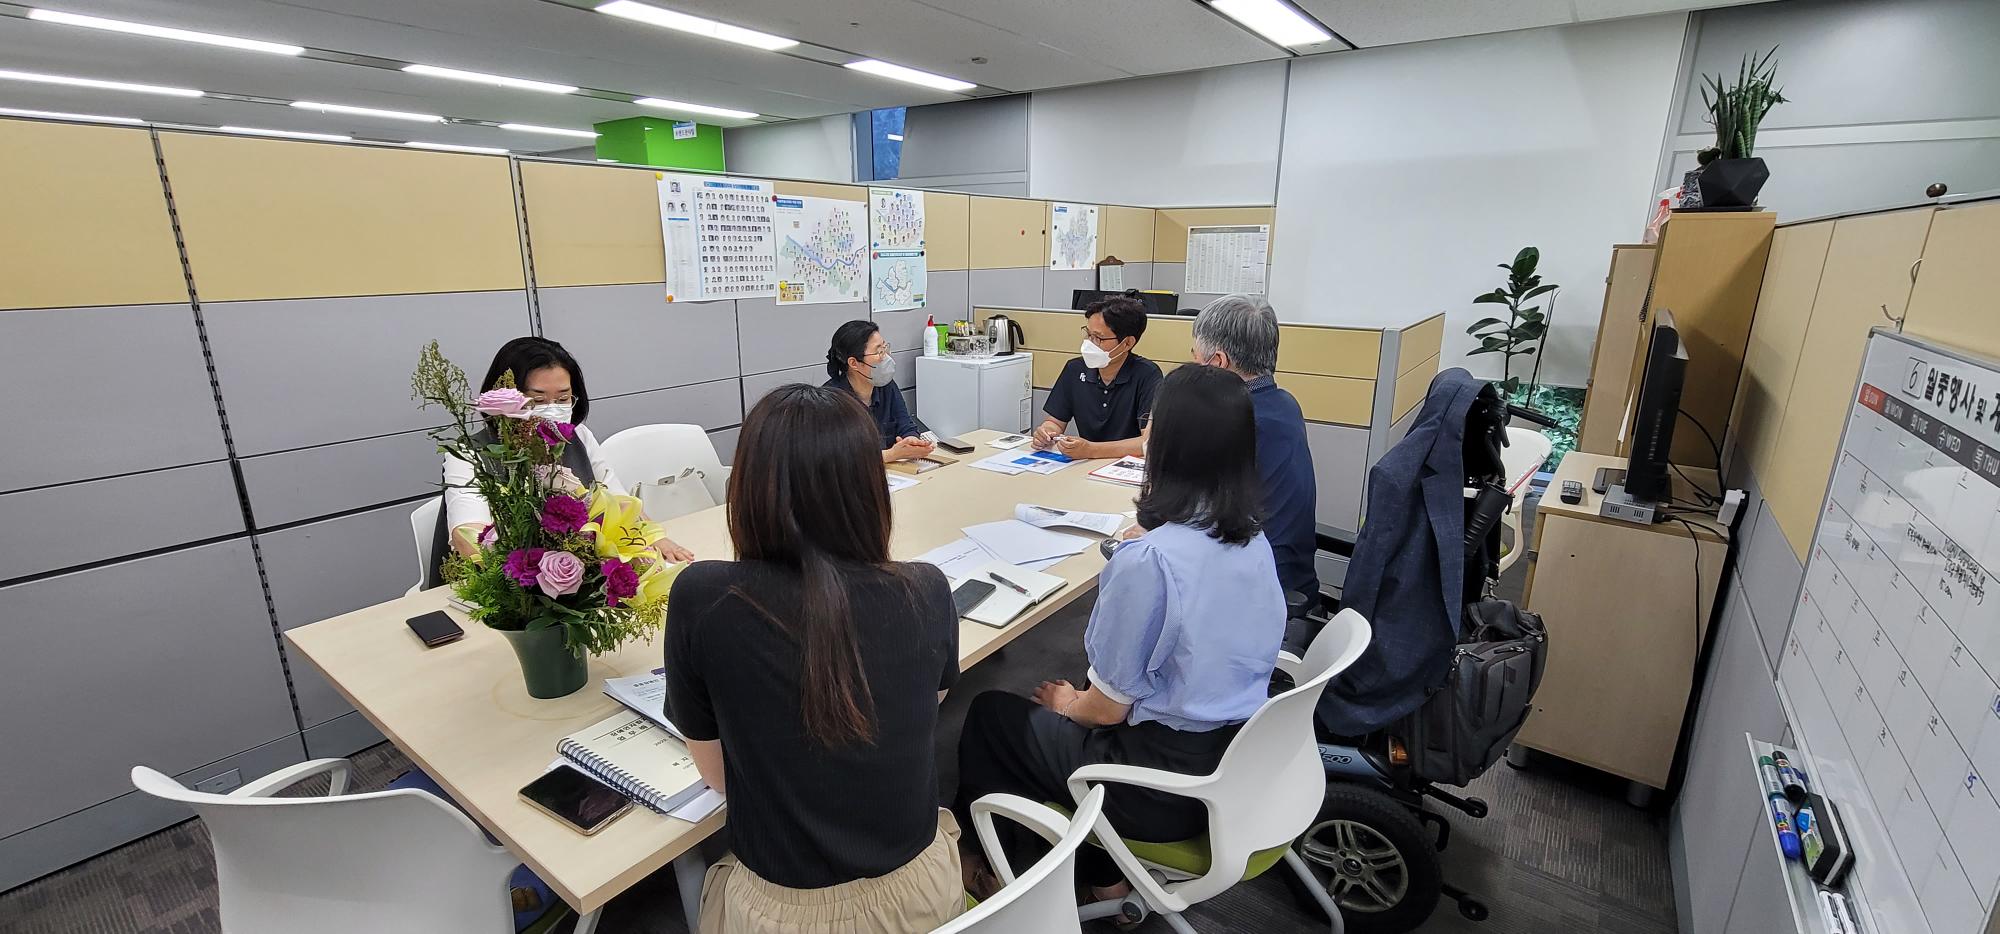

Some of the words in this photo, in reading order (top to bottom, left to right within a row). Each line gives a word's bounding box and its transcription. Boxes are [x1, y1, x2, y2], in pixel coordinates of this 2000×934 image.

[1909, 361, 1920, 390] 6
[1924, 367, 1977, 419] 월중행사
[1974, 398, 1987, 424] 및
[1945, 432, 1961, 453] WED
[1982, 453, 2000, 476] THU
